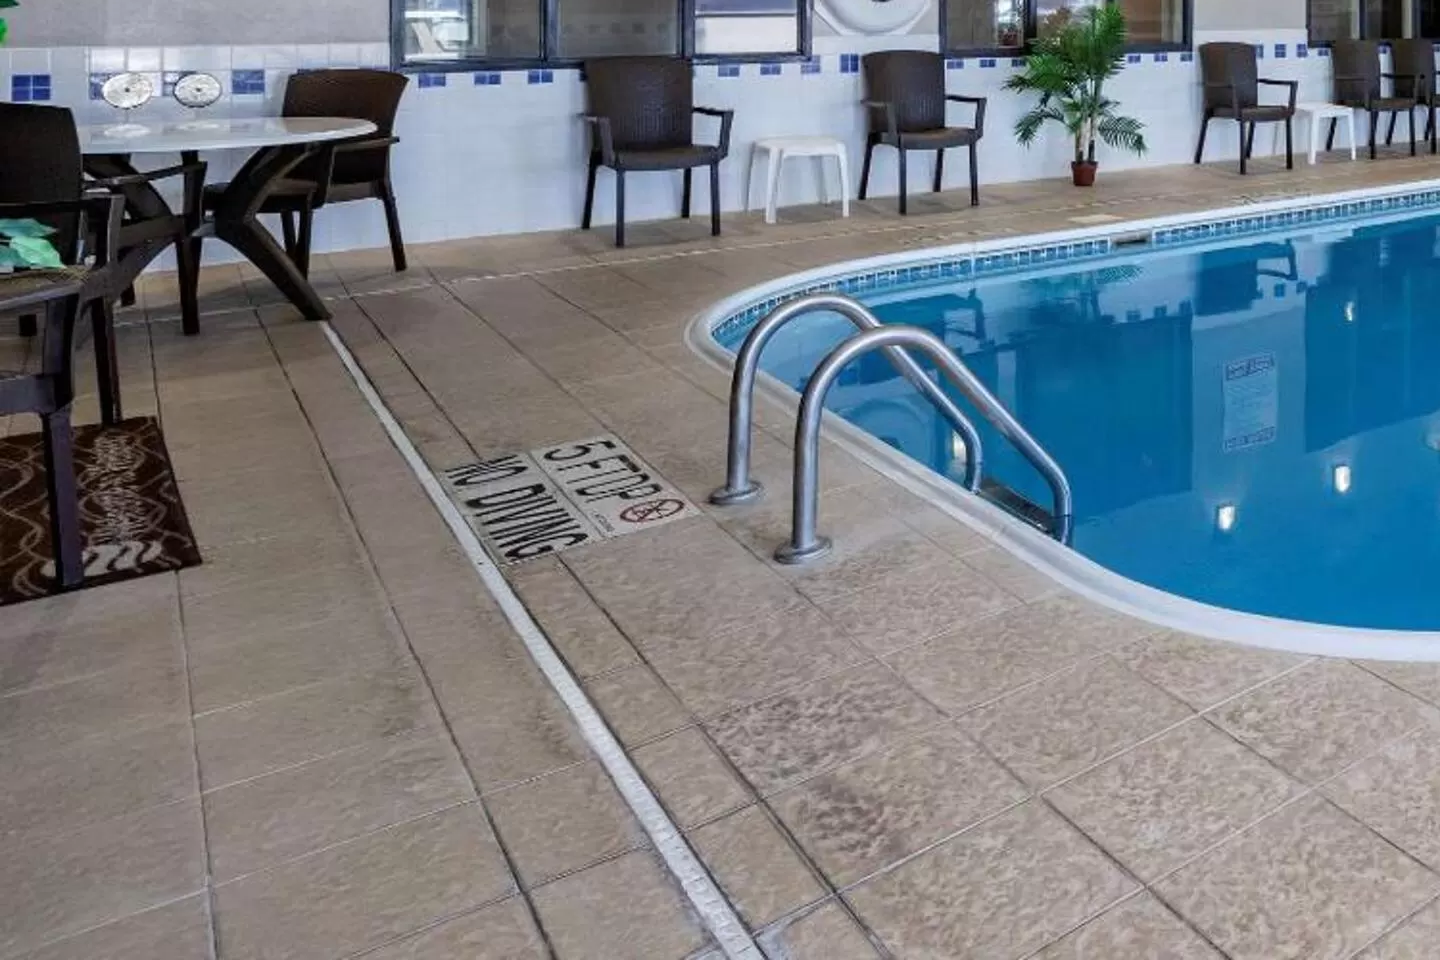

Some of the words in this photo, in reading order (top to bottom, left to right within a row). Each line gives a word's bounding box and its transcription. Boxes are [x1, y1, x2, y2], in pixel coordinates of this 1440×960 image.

[543, 440, 617, 462] 5
[445, 454, 529, 487] NO
[464, 483, 589, 560] DIVING
